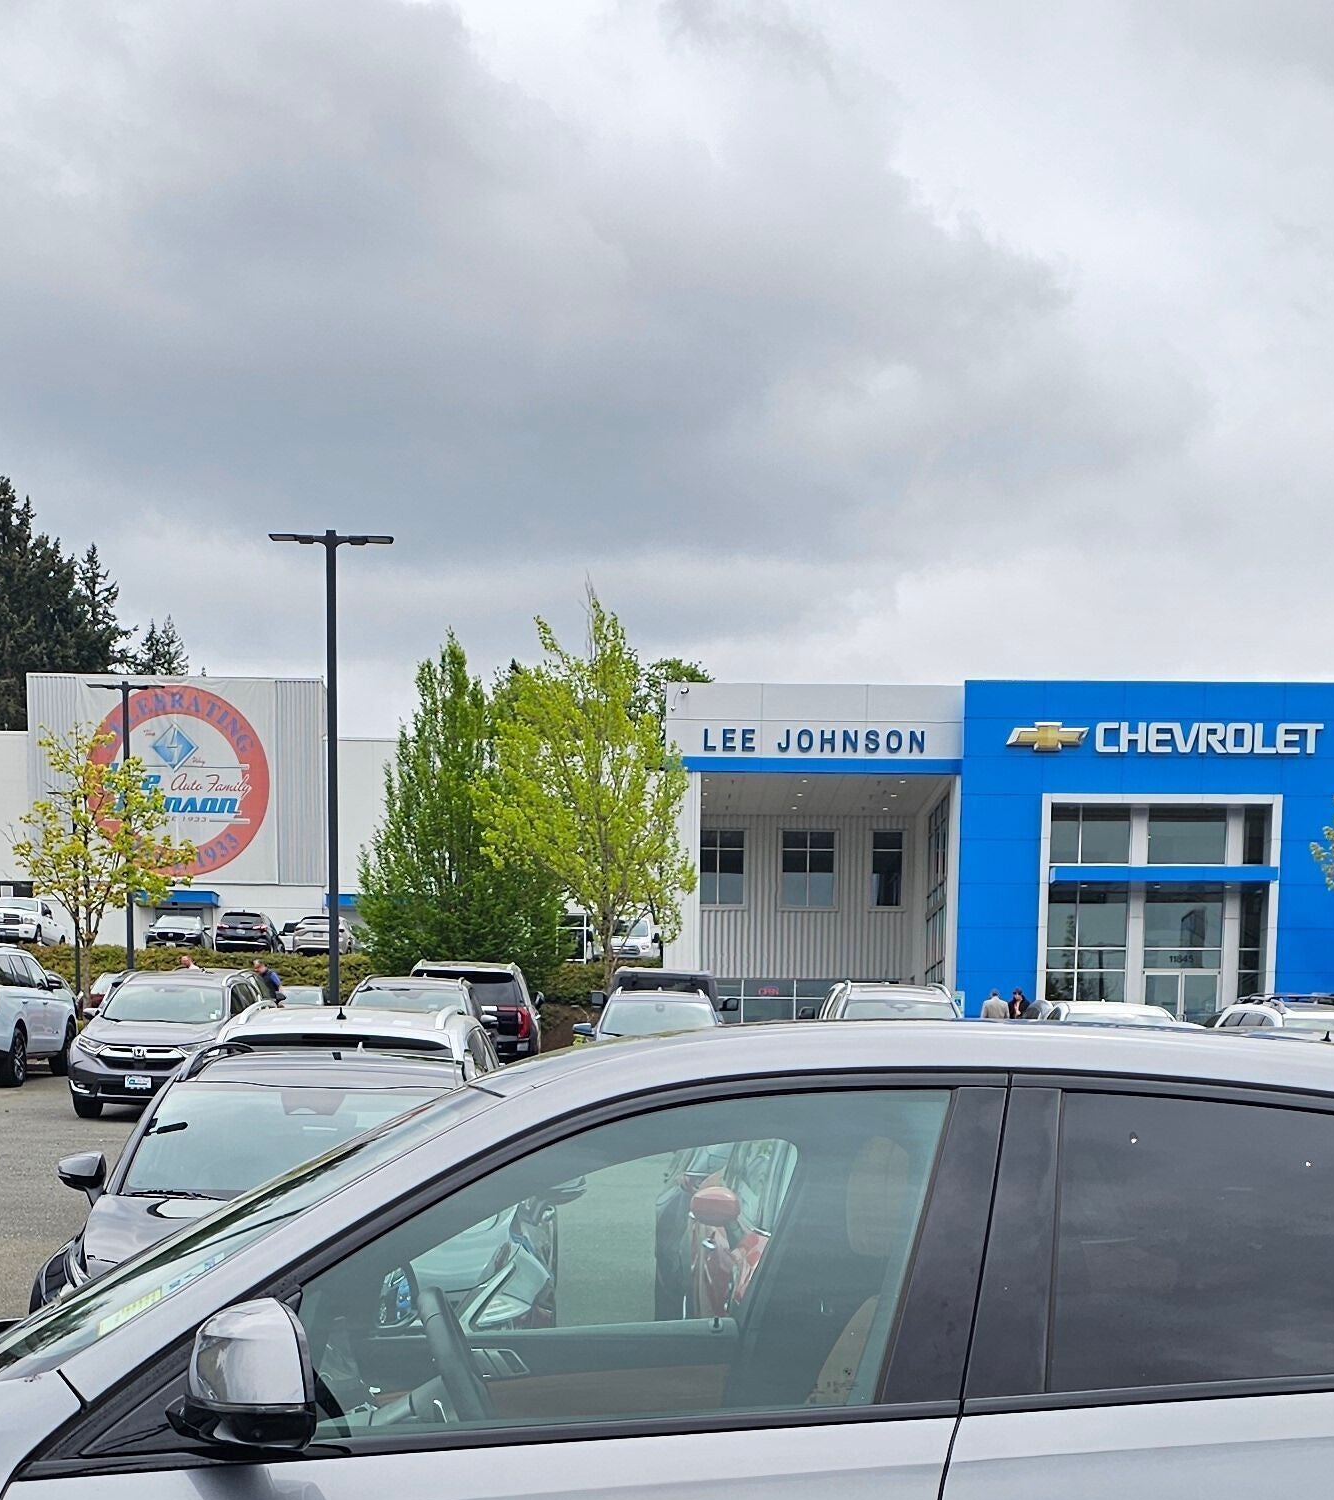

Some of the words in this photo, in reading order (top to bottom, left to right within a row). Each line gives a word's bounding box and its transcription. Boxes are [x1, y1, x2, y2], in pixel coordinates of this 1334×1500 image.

[703, 728, 756, 752] LEE
[777, 729, 926, 754] JOHNSON
[1094, 721, 1325, 755] CHEVROLET
[170, 773, 203, 792] Auto
[205, 774, 252, 797] Family
